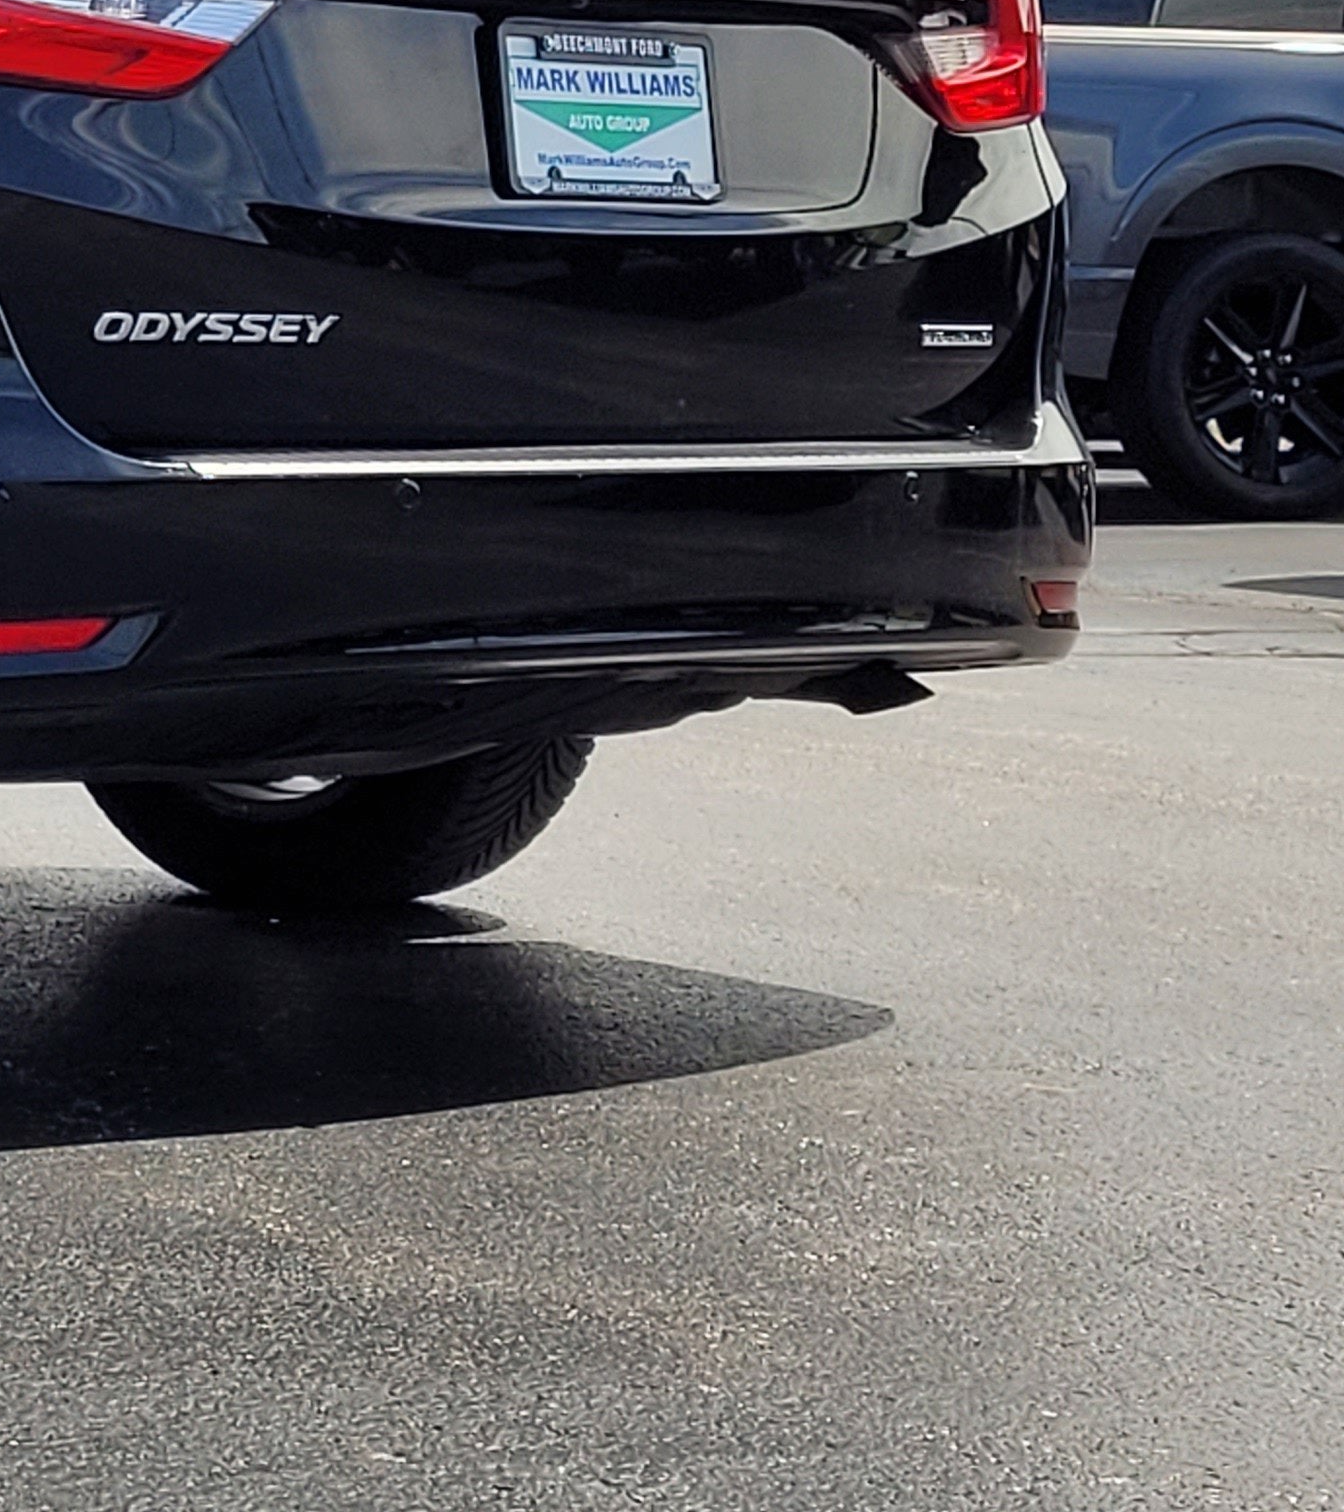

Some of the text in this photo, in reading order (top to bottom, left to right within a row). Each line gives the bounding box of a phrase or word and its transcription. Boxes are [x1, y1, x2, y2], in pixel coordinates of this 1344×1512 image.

[552, 33, 663, 58] BEECHMONT FORD
[516, 66, 696, 98] MARK WILLIAMS
[568, 113, 651, 133] AUTO GROUP
[92, 311, 341, 343] ODYSSEY
